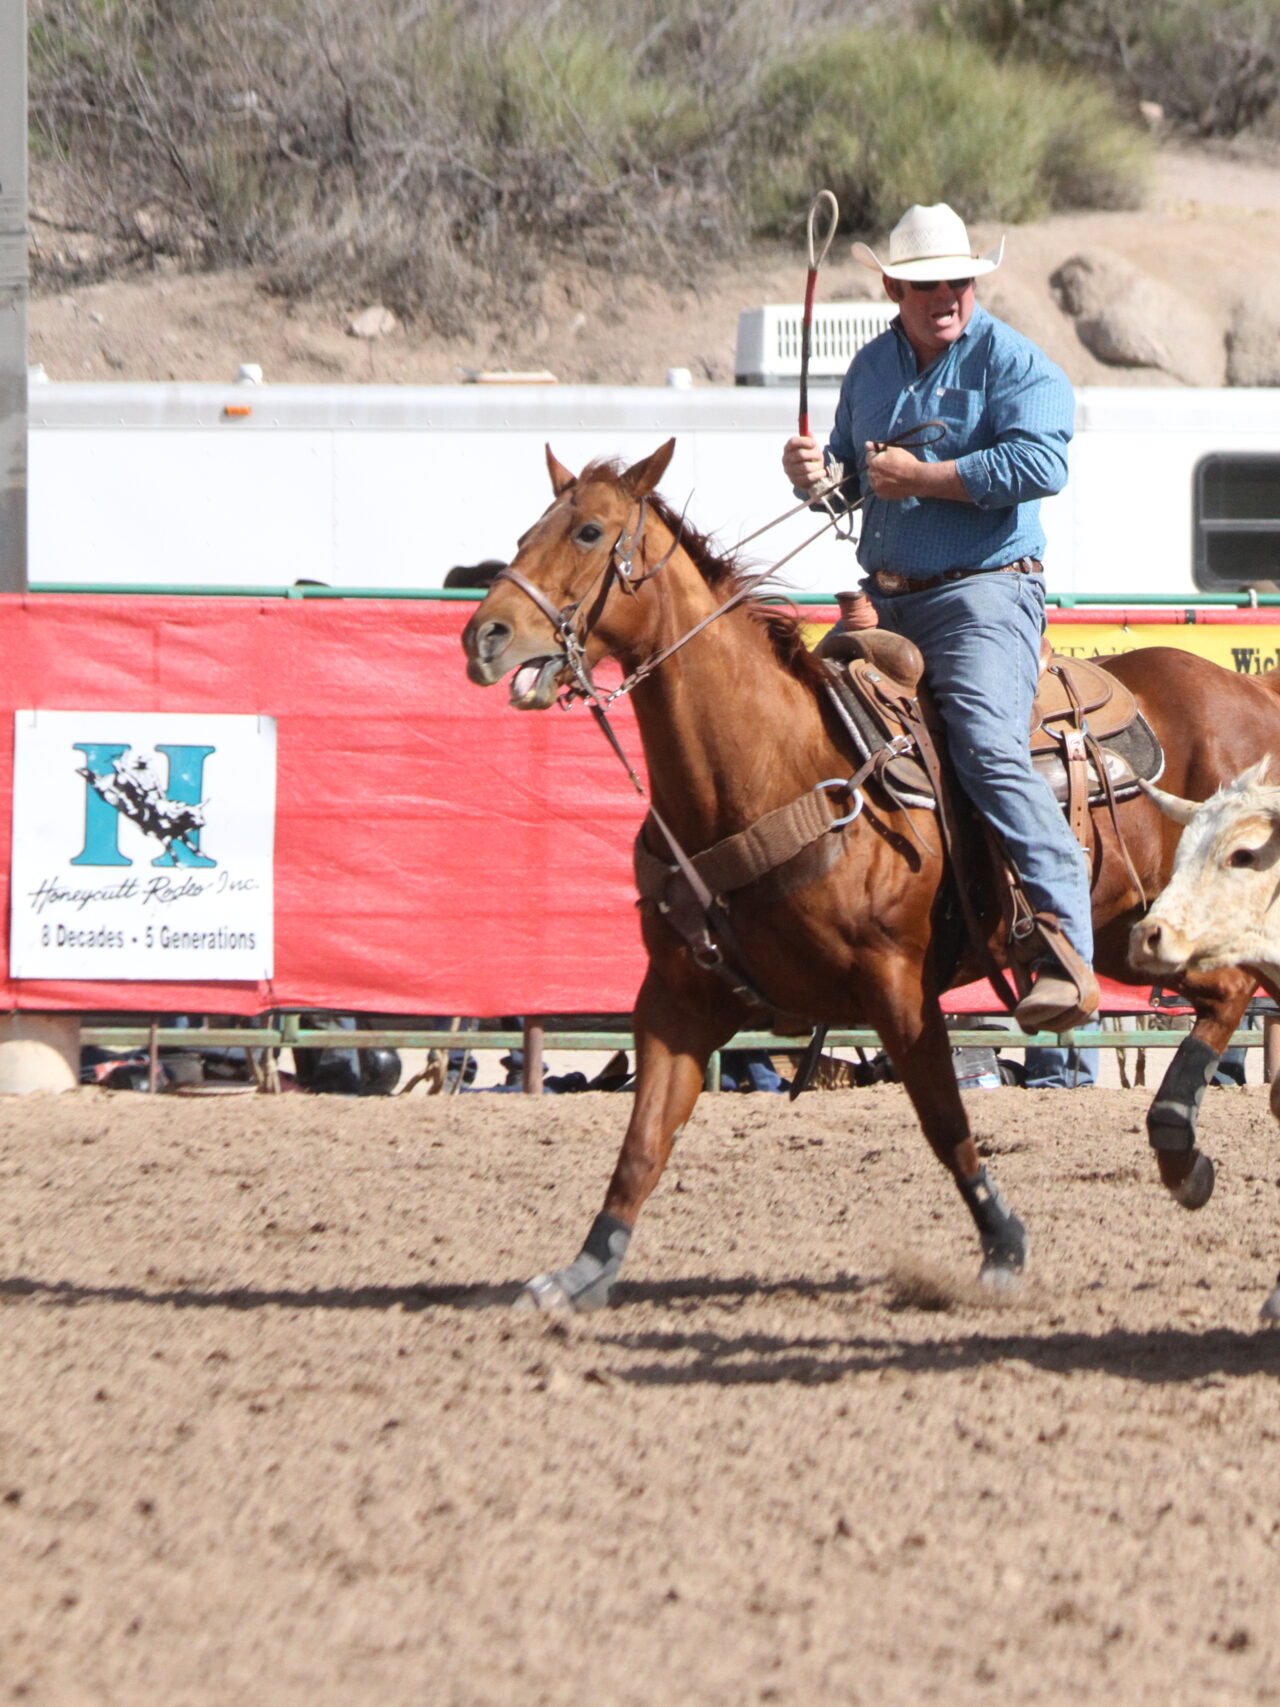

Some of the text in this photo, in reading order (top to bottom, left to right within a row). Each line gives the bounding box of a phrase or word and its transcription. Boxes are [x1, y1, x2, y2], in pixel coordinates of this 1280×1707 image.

[28, 876, 140, 915] Honeycutt
[143, 875, 214, 905] Rodeo
[42, 924, 256, 950] 8 Decades 5 Generations
